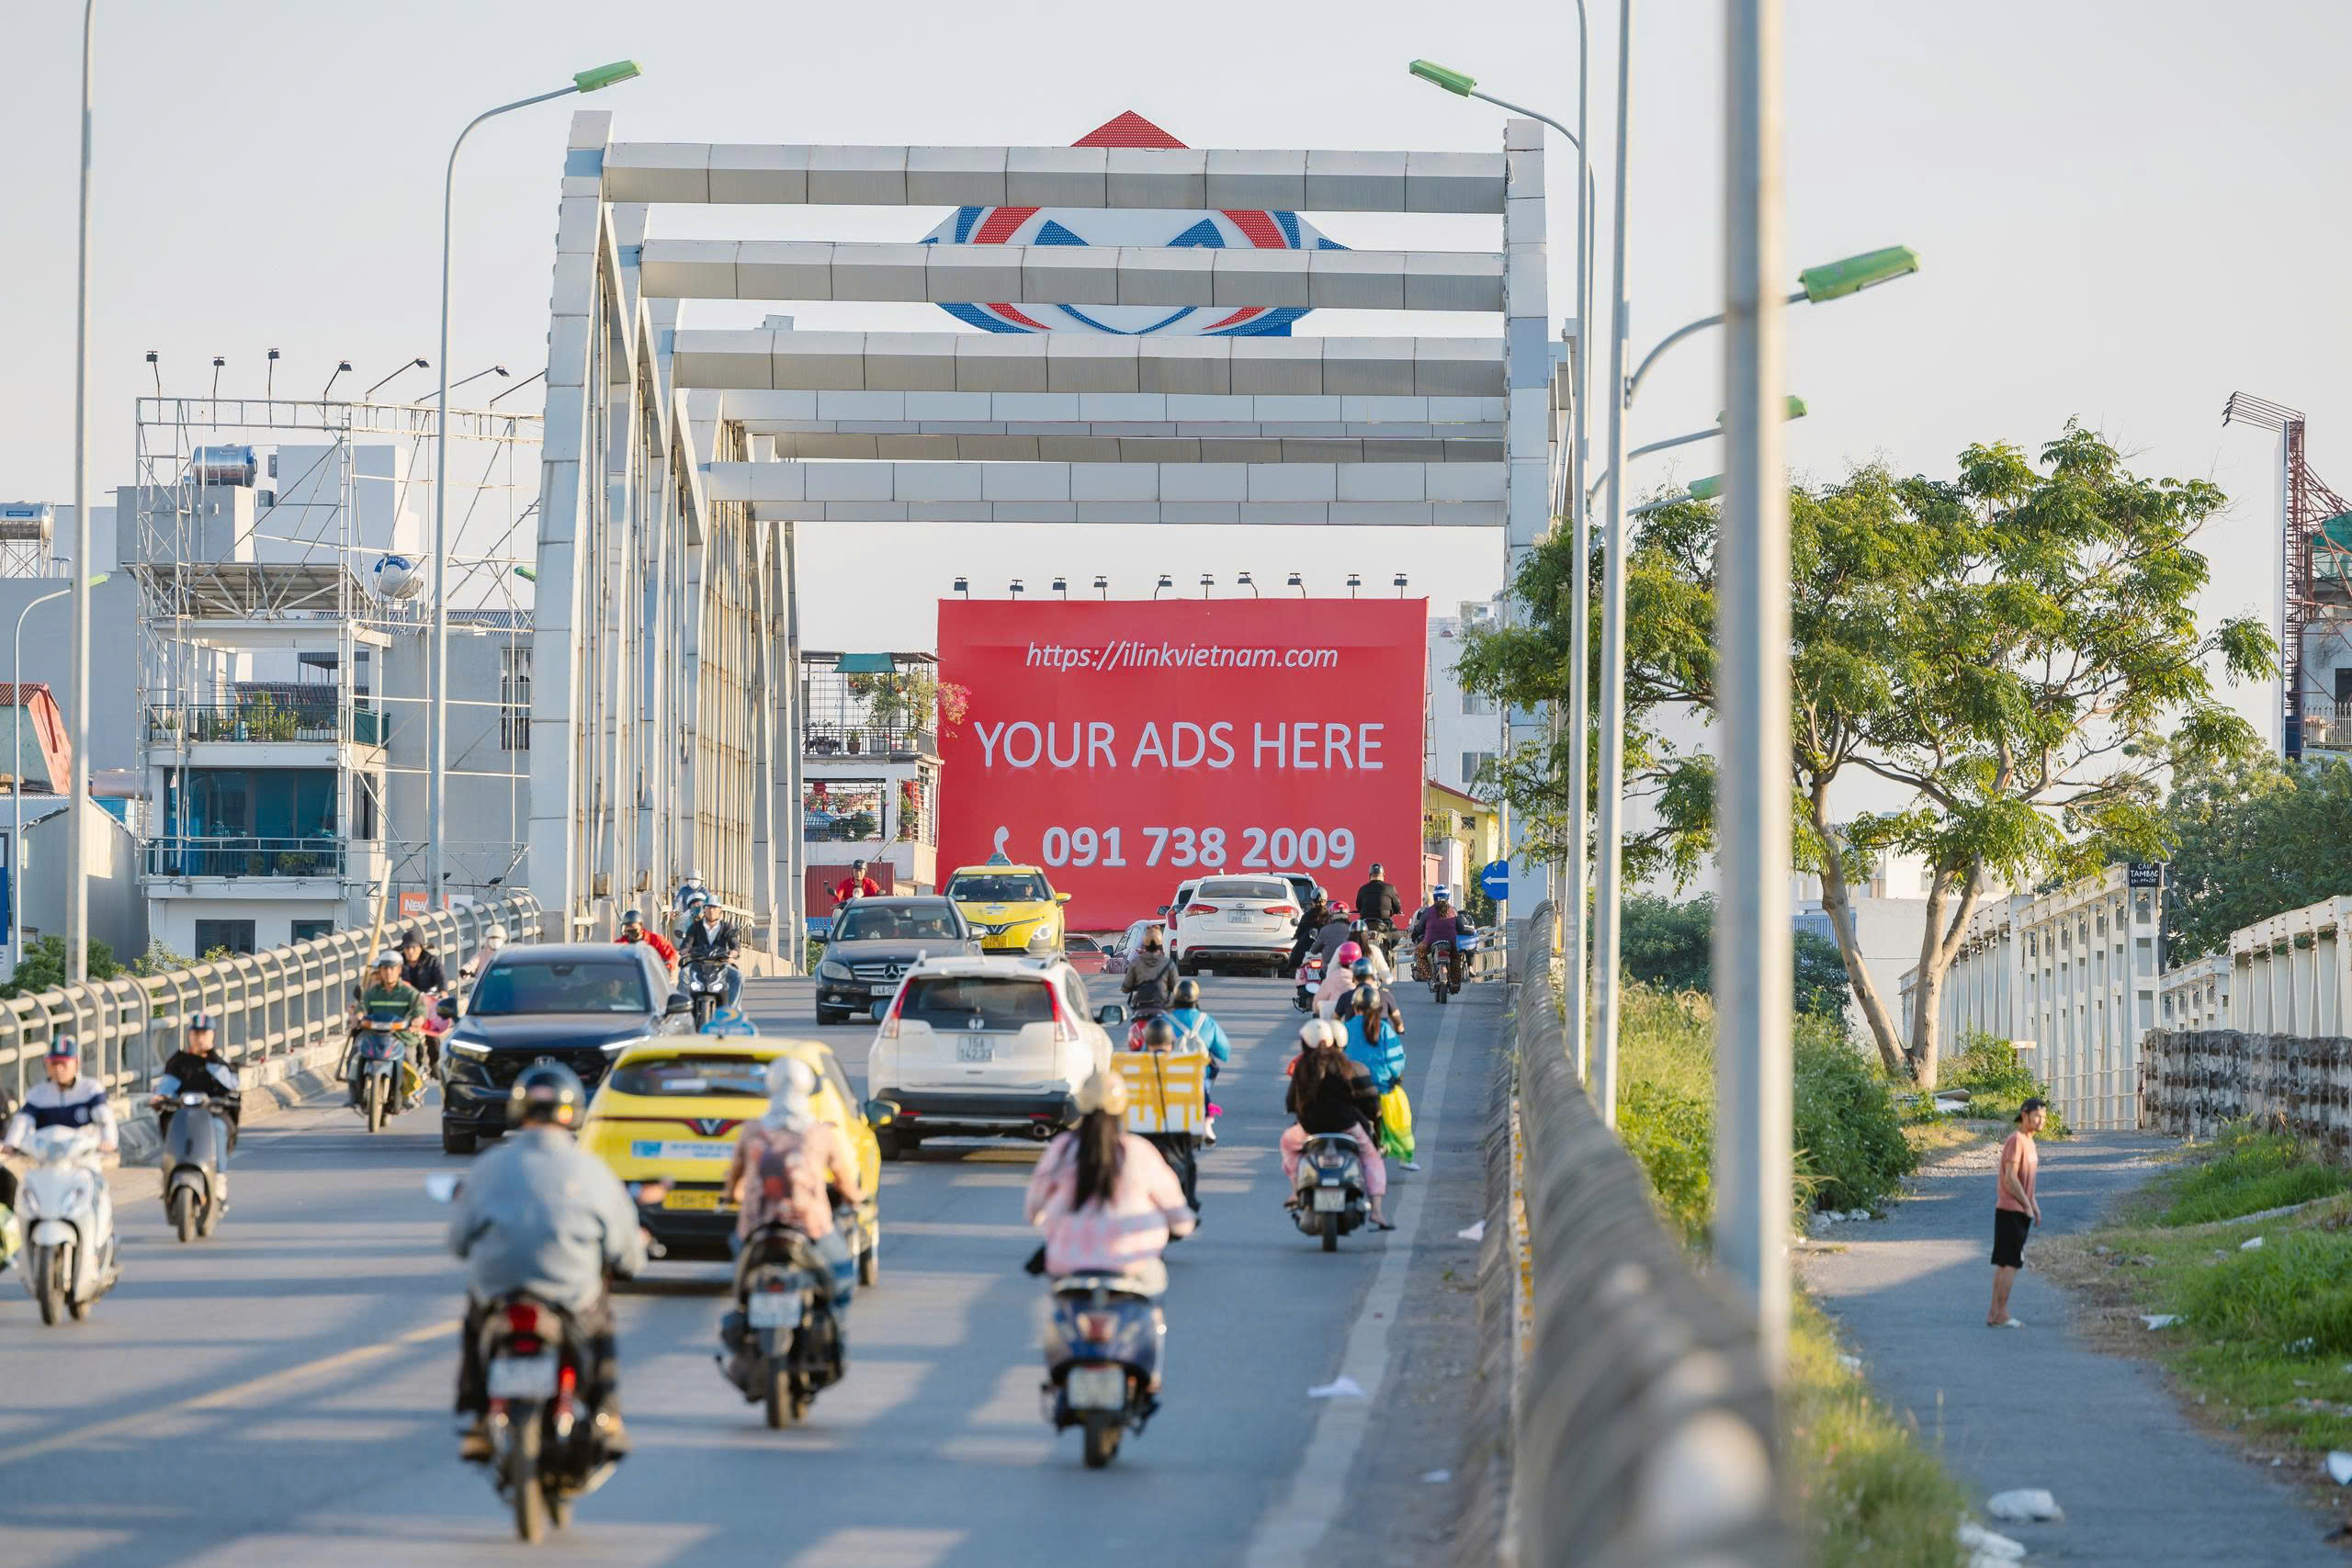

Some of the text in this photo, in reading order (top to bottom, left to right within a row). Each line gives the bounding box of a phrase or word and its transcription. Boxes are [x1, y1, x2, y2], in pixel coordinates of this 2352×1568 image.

[1026, 640, 1339, 672] https://ilinkvietnam.com
[974, 721, 1385, 770] YOUR ADS HERE
[1042, 827, 1356, 869] 091 738 2009
[968, 1036, 984, 1048] 15A
